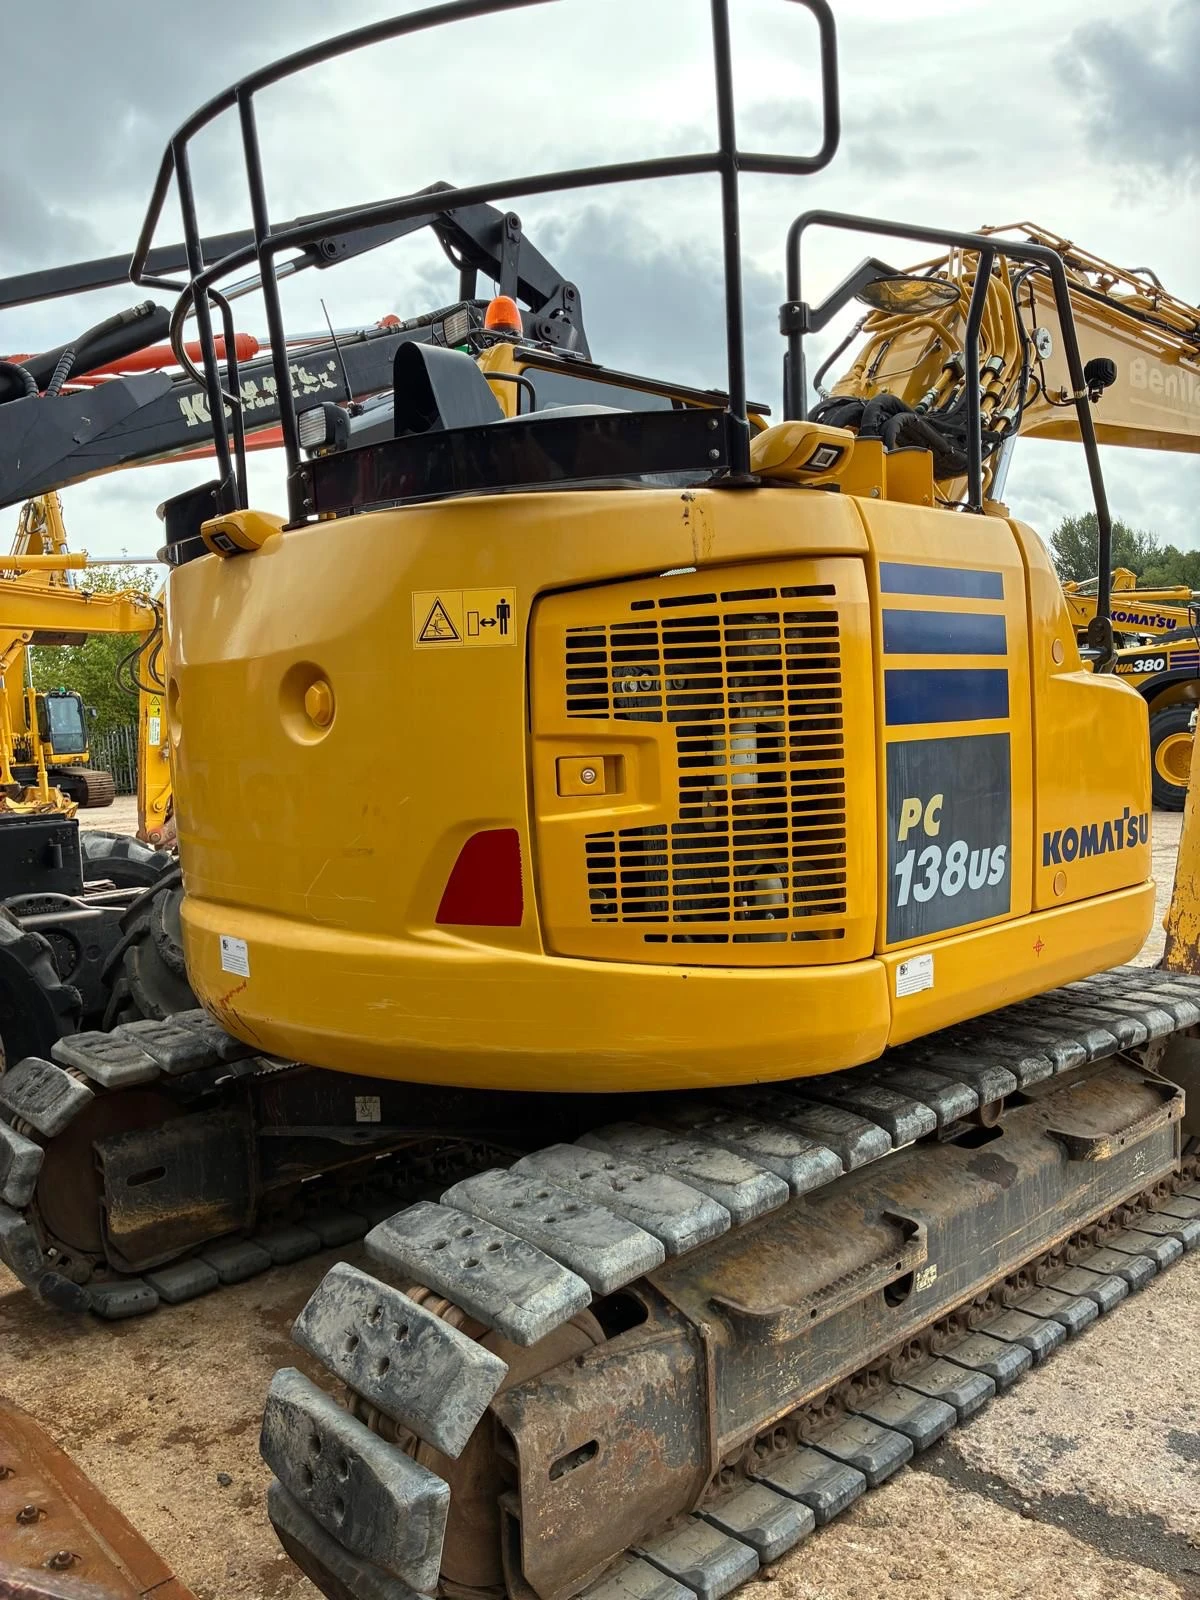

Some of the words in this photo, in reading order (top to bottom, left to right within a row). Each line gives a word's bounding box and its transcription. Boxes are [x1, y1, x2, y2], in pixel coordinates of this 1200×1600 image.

[1115, 658, 1165, 673] WA380
[897, 793, 944, 842] PC
[1042, 806, 1149, 867] KOMATSU
[894, 839, 1007, 907] 138US
